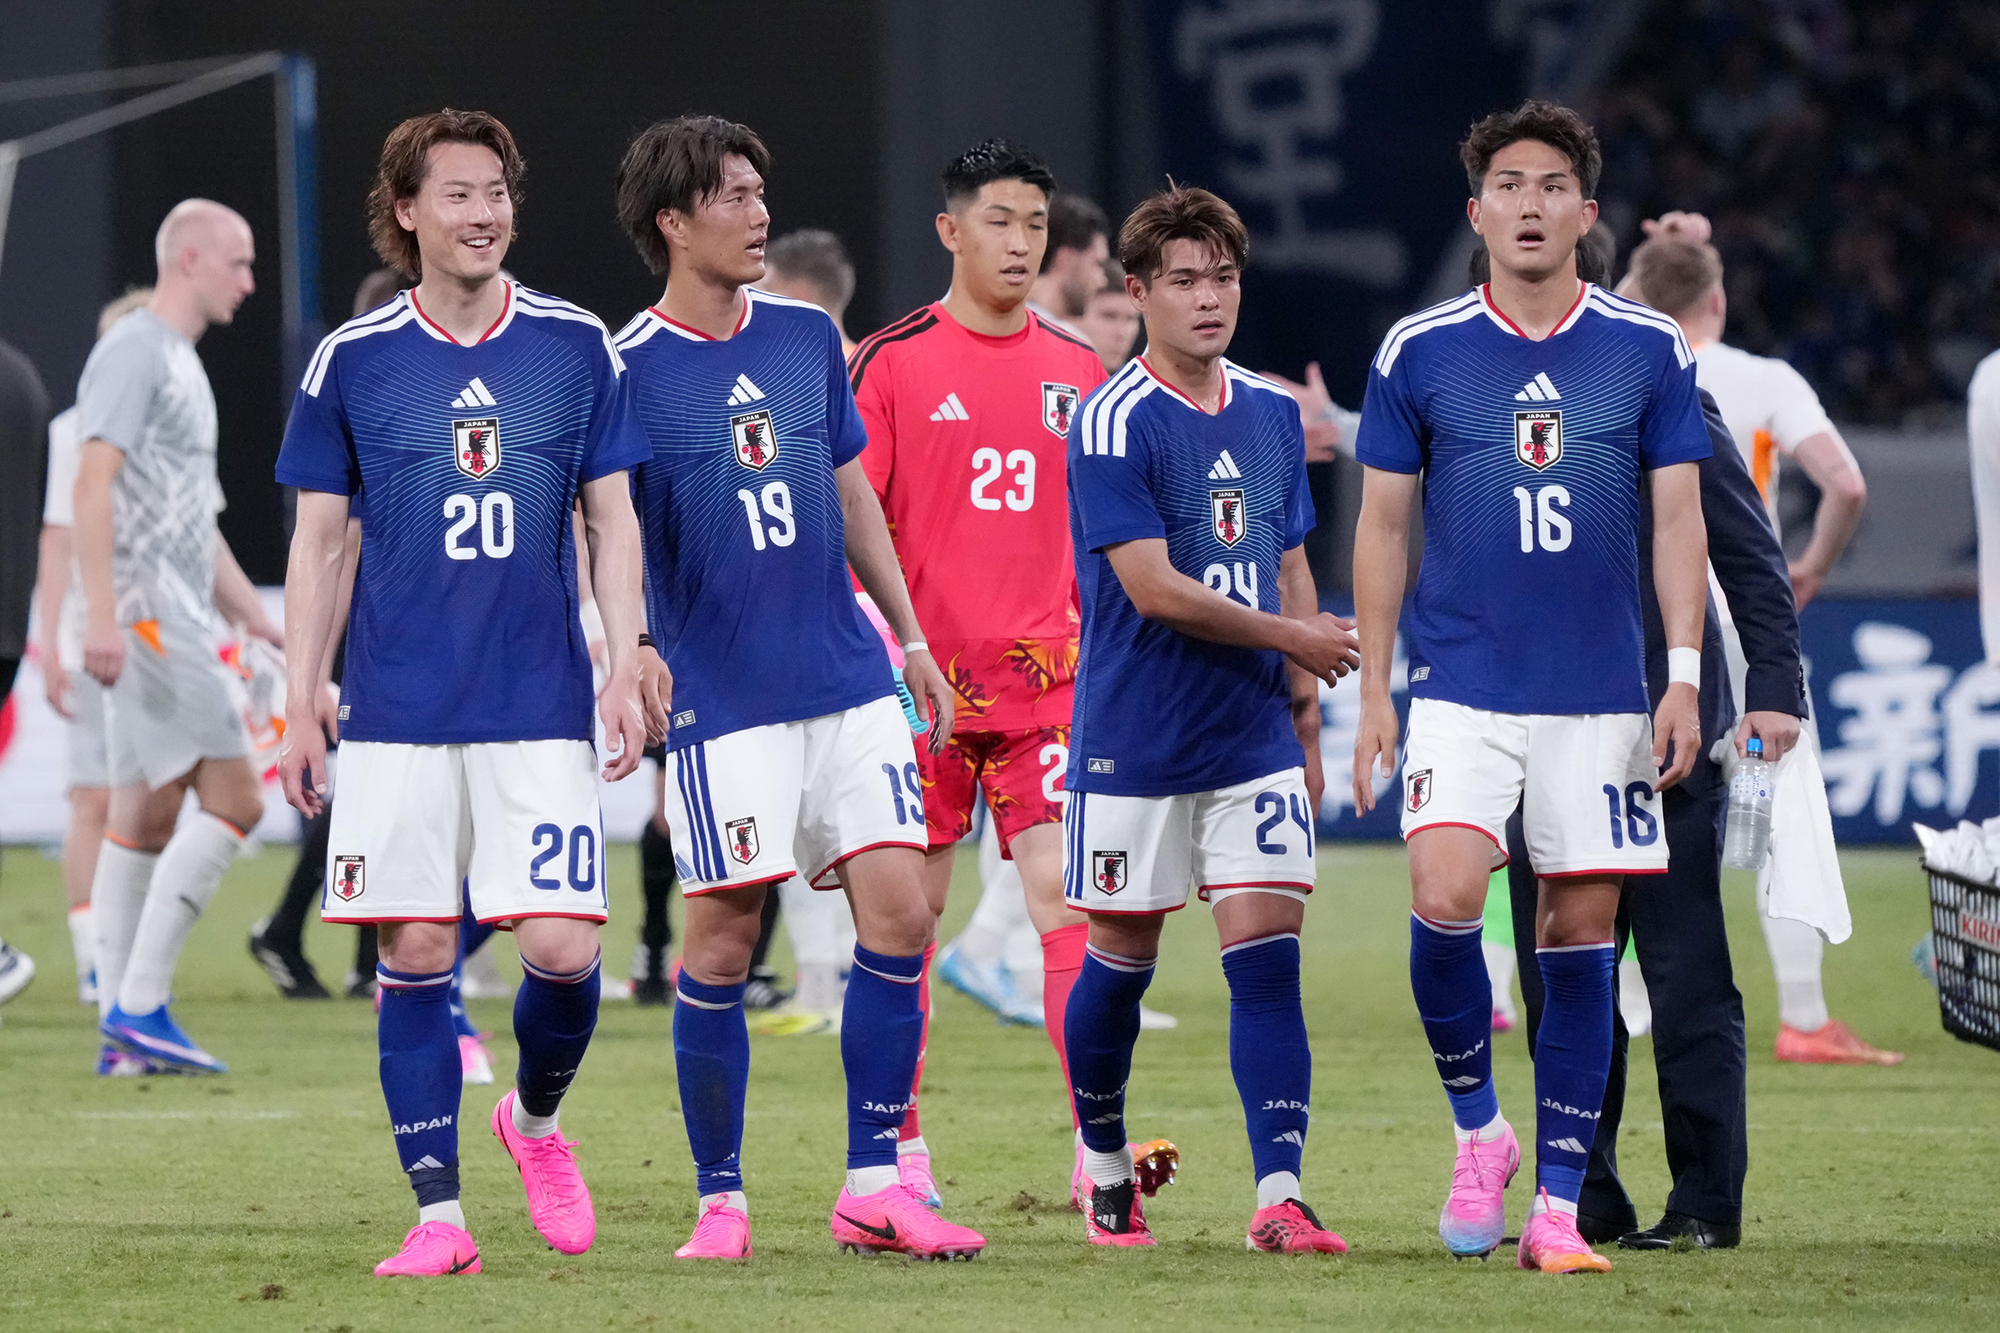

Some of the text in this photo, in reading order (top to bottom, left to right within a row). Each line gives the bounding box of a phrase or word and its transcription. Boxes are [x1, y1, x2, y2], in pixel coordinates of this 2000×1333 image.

[463, 420, 488, 428] JAPAN
[738, 413, 760, 423] JAPAN
[468, 459, 488, 470] JFA
[748, 450, 768, 462] JFA
[1529, 451, 1550, 461] JFA
[971, 447, 1036, 512] 23
[443, 492, 514, 560] 20
[738, 481, 796, 551] 19
[1513, 485, 1572, 553] 16
[1222, 528, 1237, 538] JFA
[1039, 744, 1069, 803] 2
[881, 761, 925, 826] 19
[1254, 791, 1312, 858] 24
[1602, 780, 1659, 849] 16
[529, 822, 596, 893] 20
[1434, 1039, 1484, 1063] APAN
[861, 1101, 909, 1114] JAPA
[1262, 1099, 1309, 1116] JAPA
[1541, 1097, 1602, 1120] JAPAN
[394, 1115, 452, 1135] JAPAN
